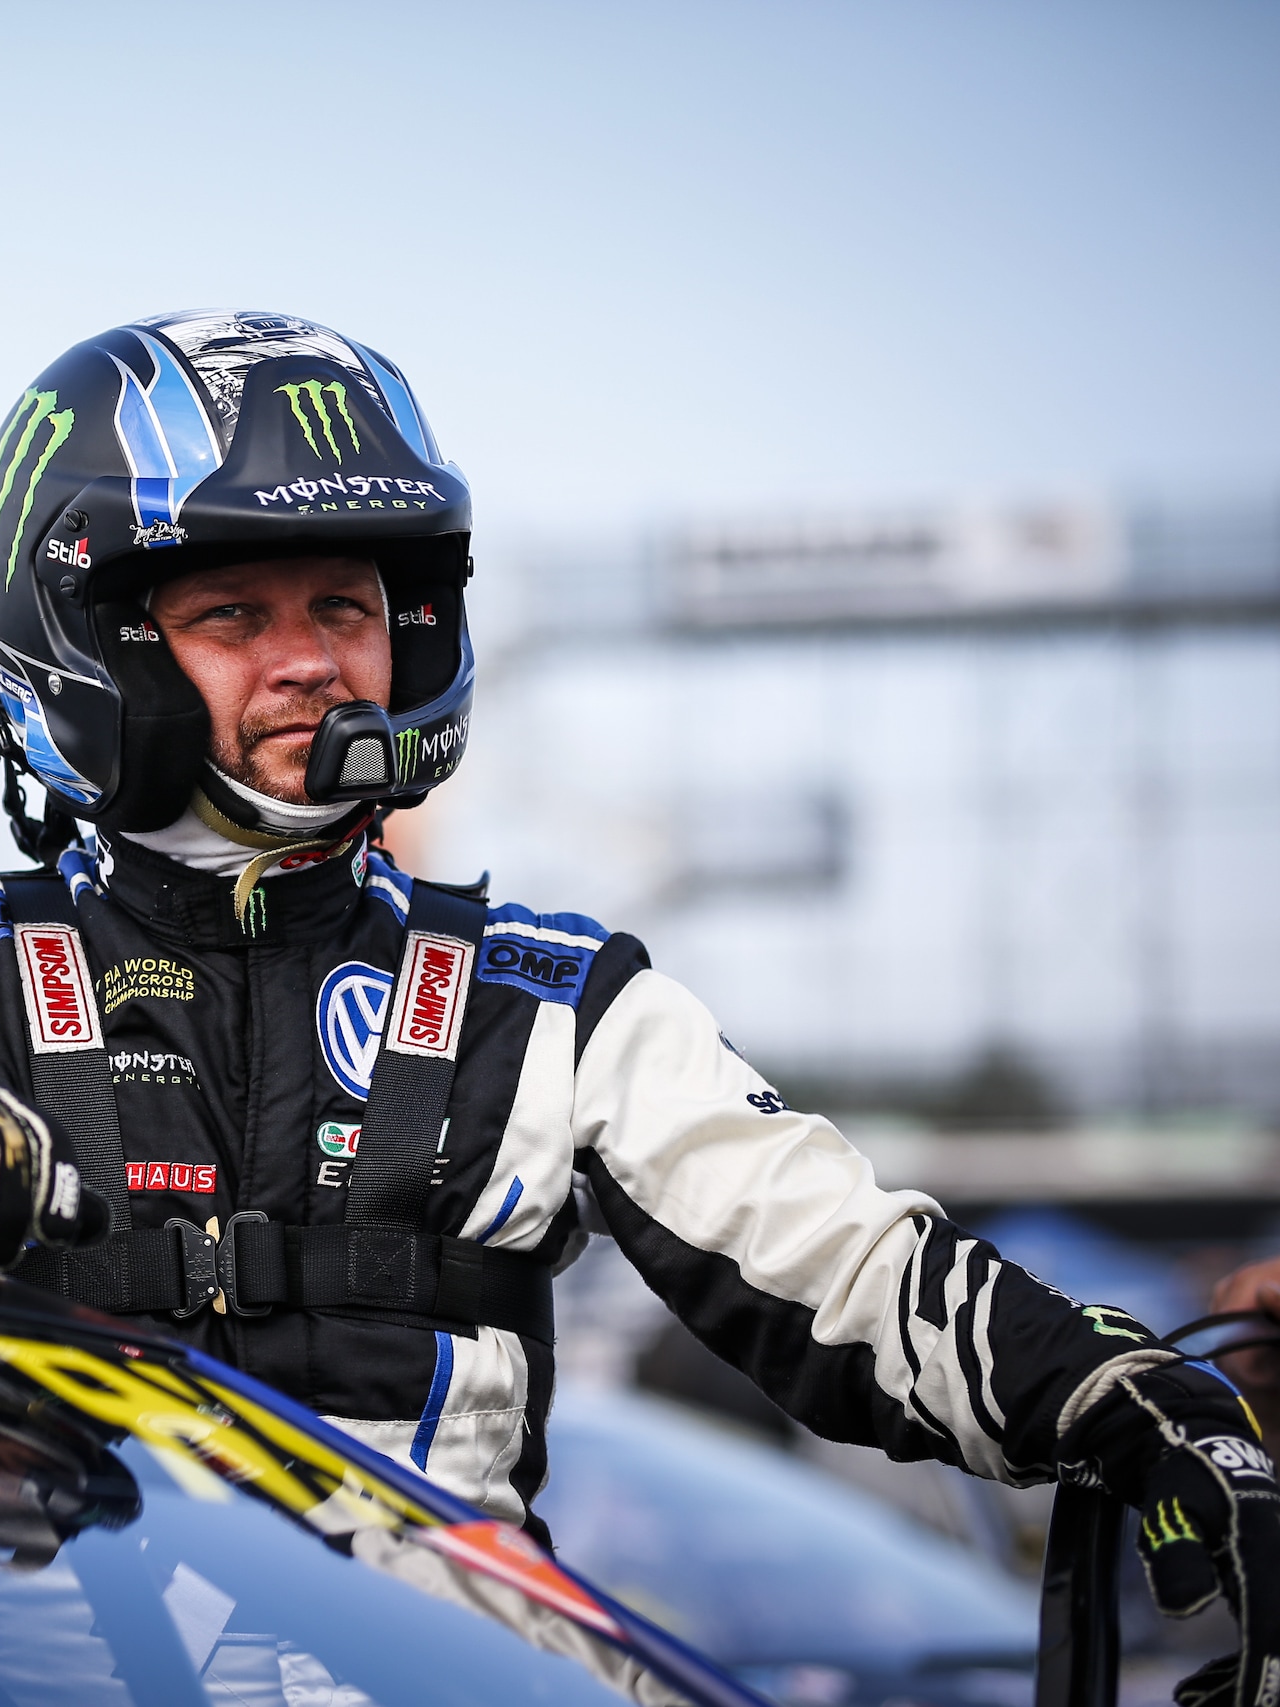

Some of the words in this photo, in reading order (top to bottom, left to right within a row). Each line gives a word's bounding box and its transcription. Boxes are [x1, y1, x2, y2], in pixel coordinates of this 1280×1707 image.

[254, 472, 447, 506] MONSTER
[46, 537, 92, 570] Stilo
[104, 964, 122, 989] FIA
[124, 957, 194, 981] WORLD
[486, 944, 580, 983] OMP
[31, 936, 82, 1037] SIMPSON
[104, 986, 194, 1015] CHAMPIONSHIP
[105, 973, 195, 1003] RALLYCROSS
[409, 946, 456, 1044] SIMPSON
[108, 1050, 196, 1077] ONSTER
[112, 1072, 194, 1085] ENERGY
